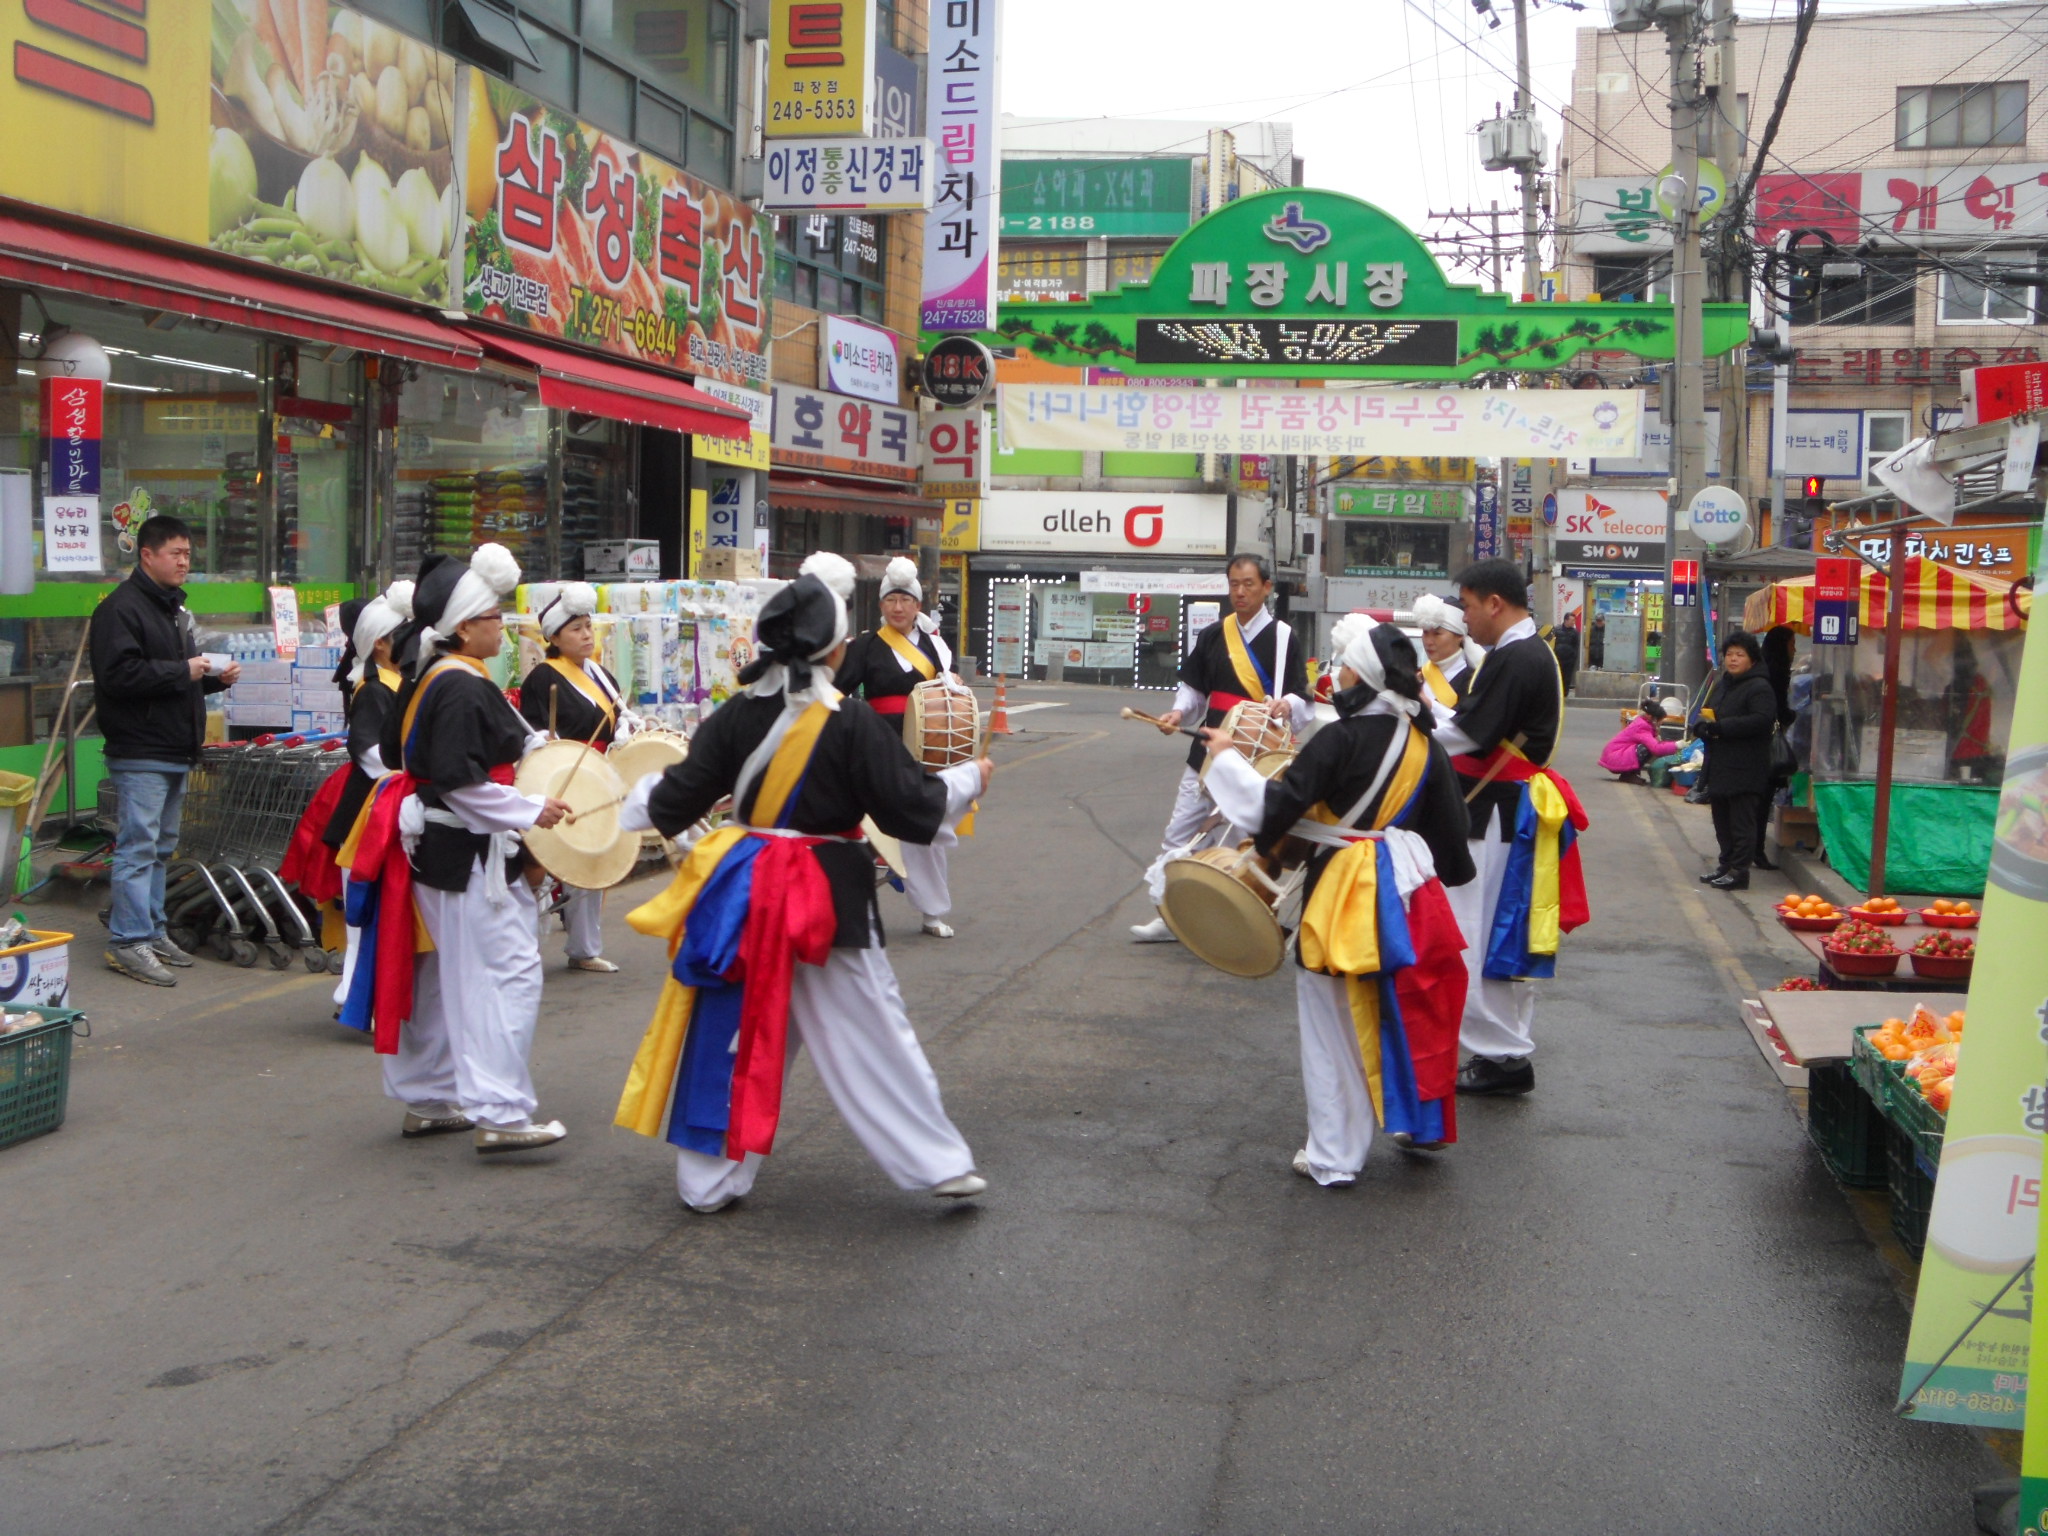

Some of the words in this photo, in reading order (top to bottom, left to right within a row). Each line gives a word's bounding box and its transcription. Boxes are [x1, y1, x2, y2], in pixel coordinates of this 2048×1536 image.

[793, 80, 838, 94] 파장점
[773, 99, 855, 121] 248-5353
[936, 0, 980, 258] 미소드림치과
[497, 114, 764, 328] 삼성축산
[843, 237, 878, 263] 247-7528
[481, 267, 548, 315] 생고기전문점
[1189, 261, 1407, 307] 파장시장
[924, 311, 985, 325] 247-7528
[843, 342, 893, 376] 미소드림치과
[931, 354, 985, 379] 18K
[929, 419, 979, 478] 약
[1372, 492, 1426, 515] 타임
[1043, 508, 1111, 533] olleh
[1566, 515, 1594, 533] SK
[1604, 519, 1667, 535] telecom
[1694, 510, 1741, 524] Lotto
[1582, 544, 1639, 559] SHOW
[1557, 583, 1566, 596] SK
